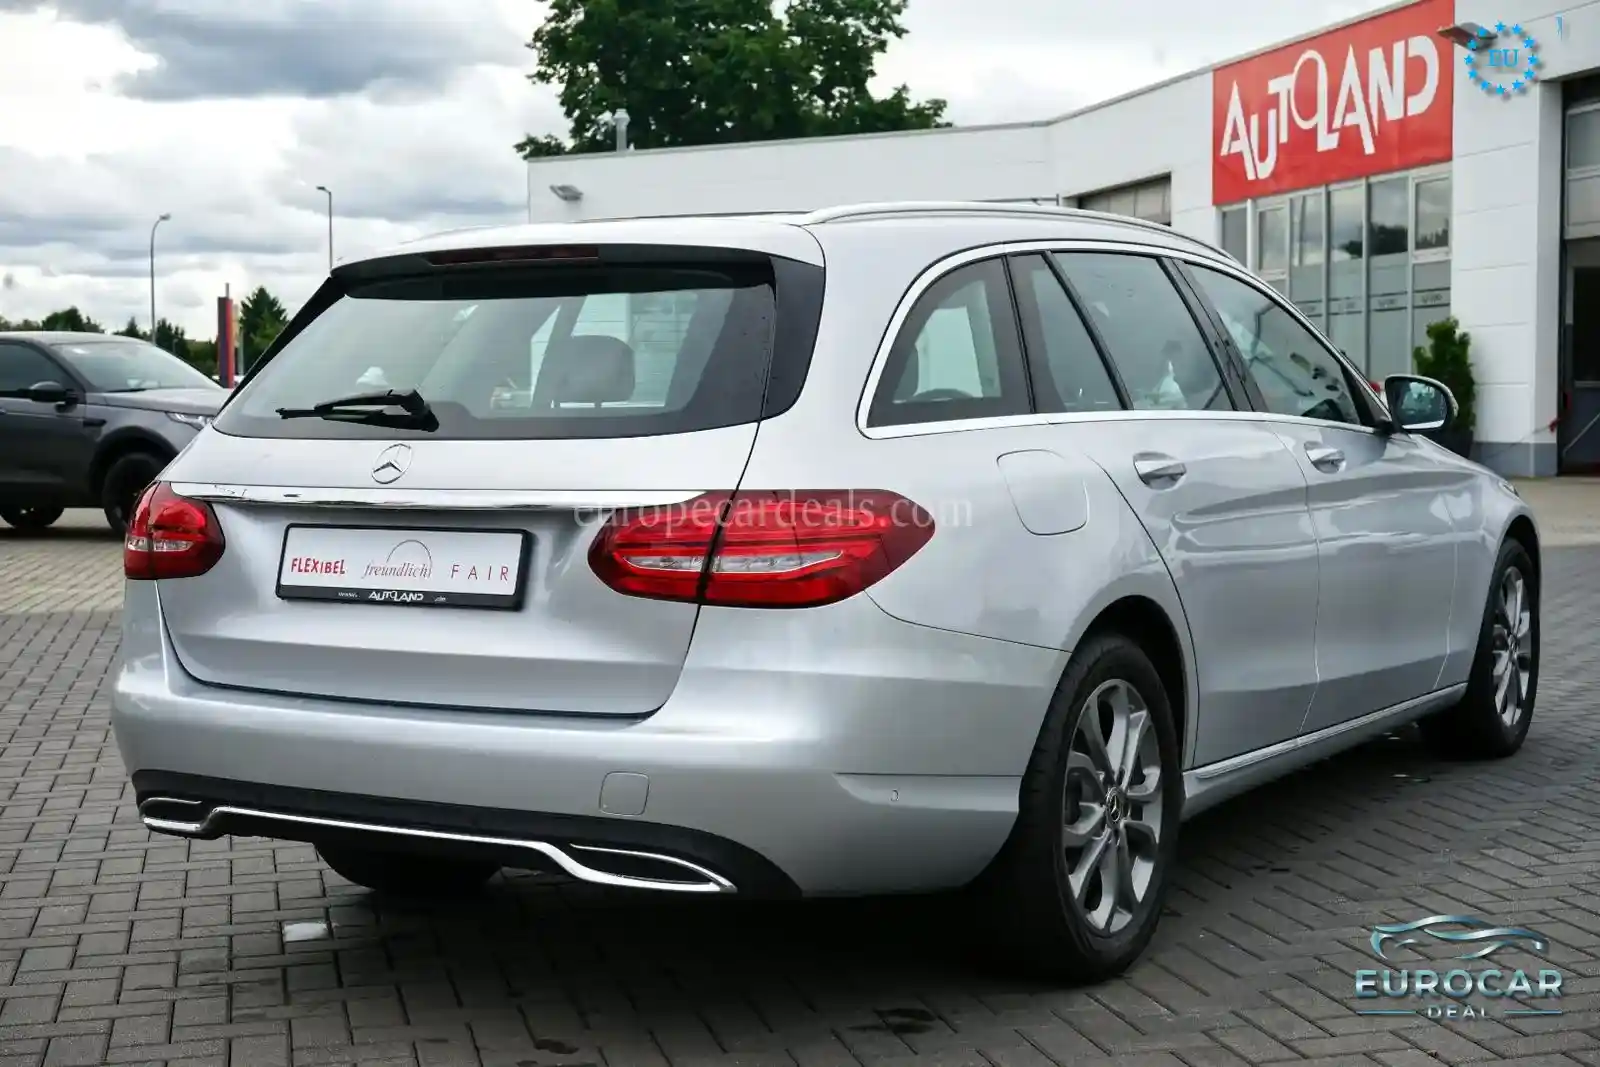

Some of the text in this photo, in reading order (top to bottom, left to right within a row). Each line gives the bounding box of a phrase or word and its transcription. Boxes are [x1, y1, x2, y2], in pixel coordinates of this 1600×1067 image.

[1220, 35, 1440, 181] AUTOLAND
[291, 557, 346, 576] FLEXIBEL
[361, 562, 432, 580] freundlich
[368, 590, 424, 602] AUTOLAND
